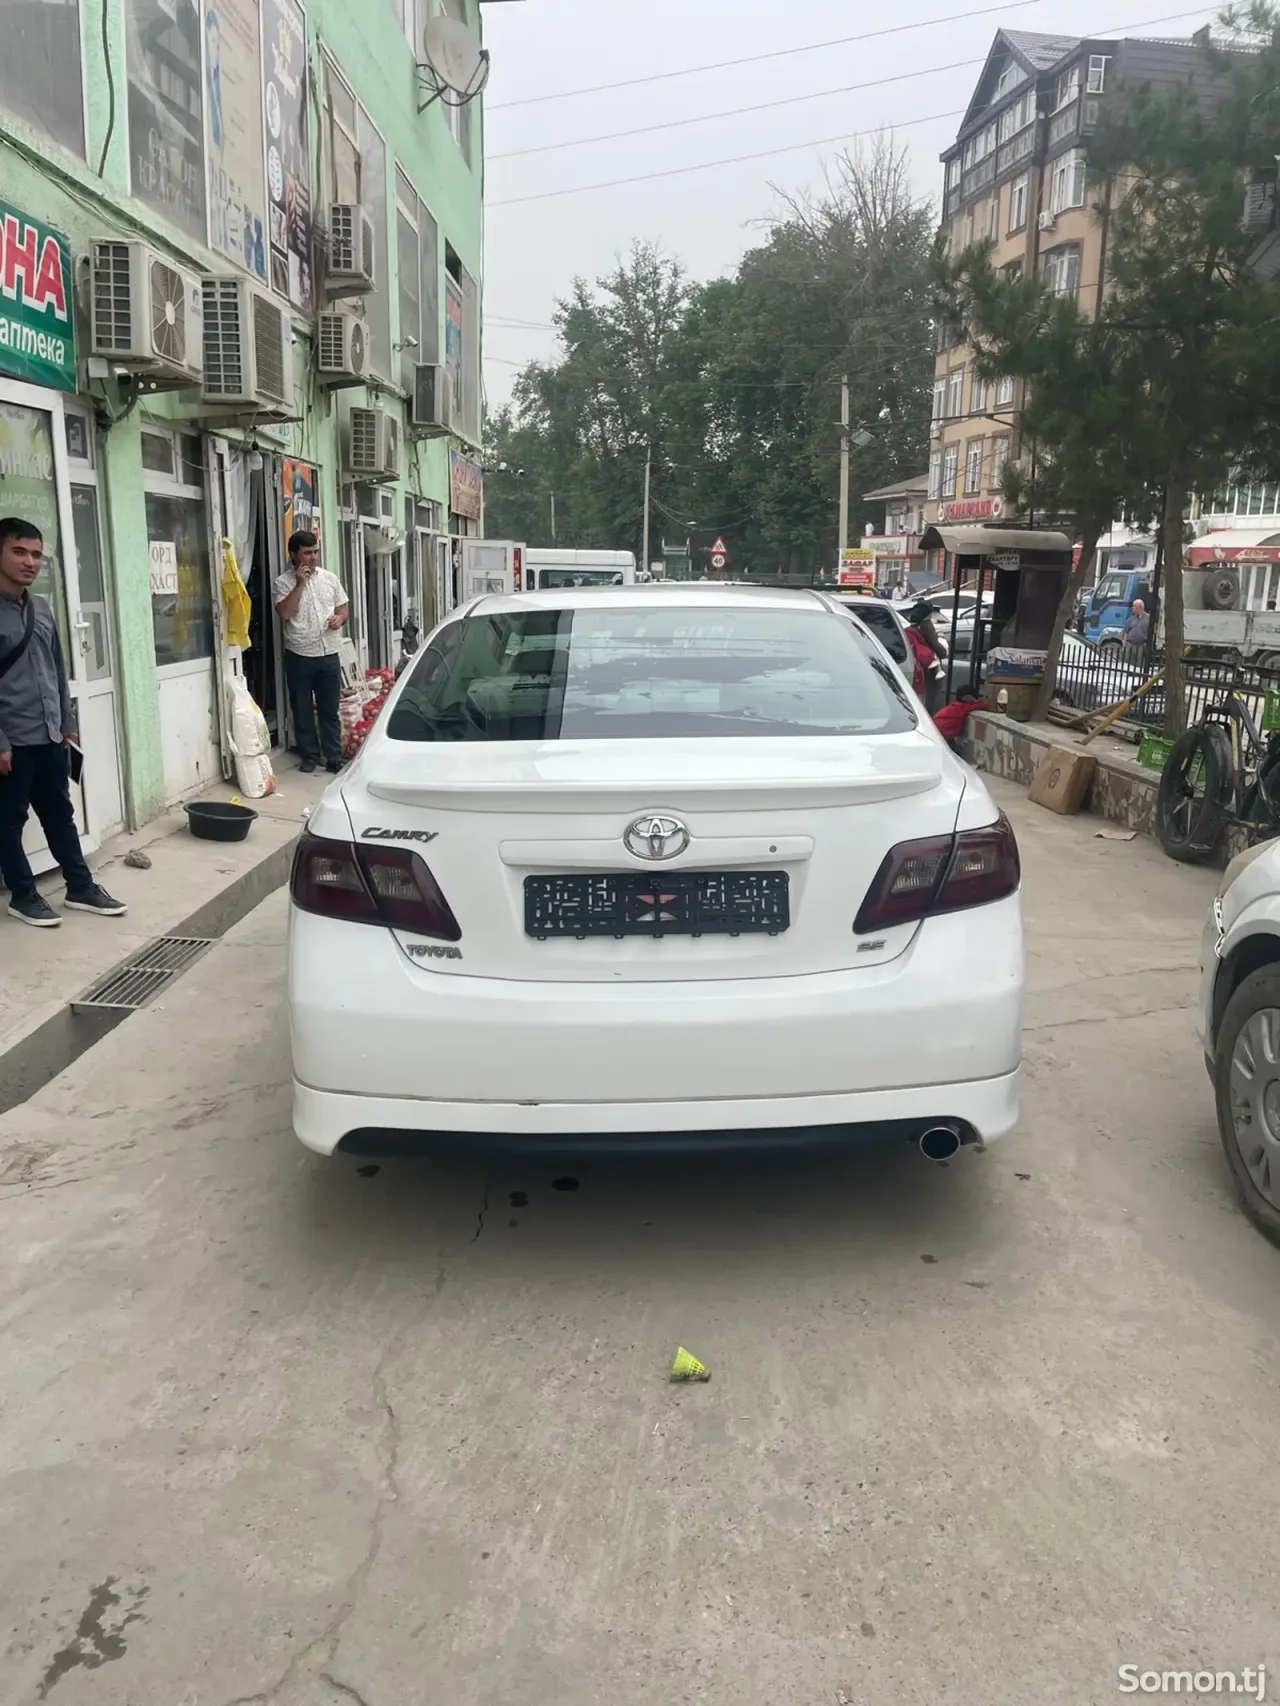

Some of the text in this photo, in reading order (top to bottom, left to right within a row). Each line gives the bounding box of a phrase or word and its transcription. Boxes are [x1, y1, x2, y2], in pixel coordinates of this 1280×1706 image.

[0, 213, 67, 322] НА
[0, 317, 65, 366] аптека
[713, 557, 722, 565] 40
[406, 944, 463, 960] TOYOTA
